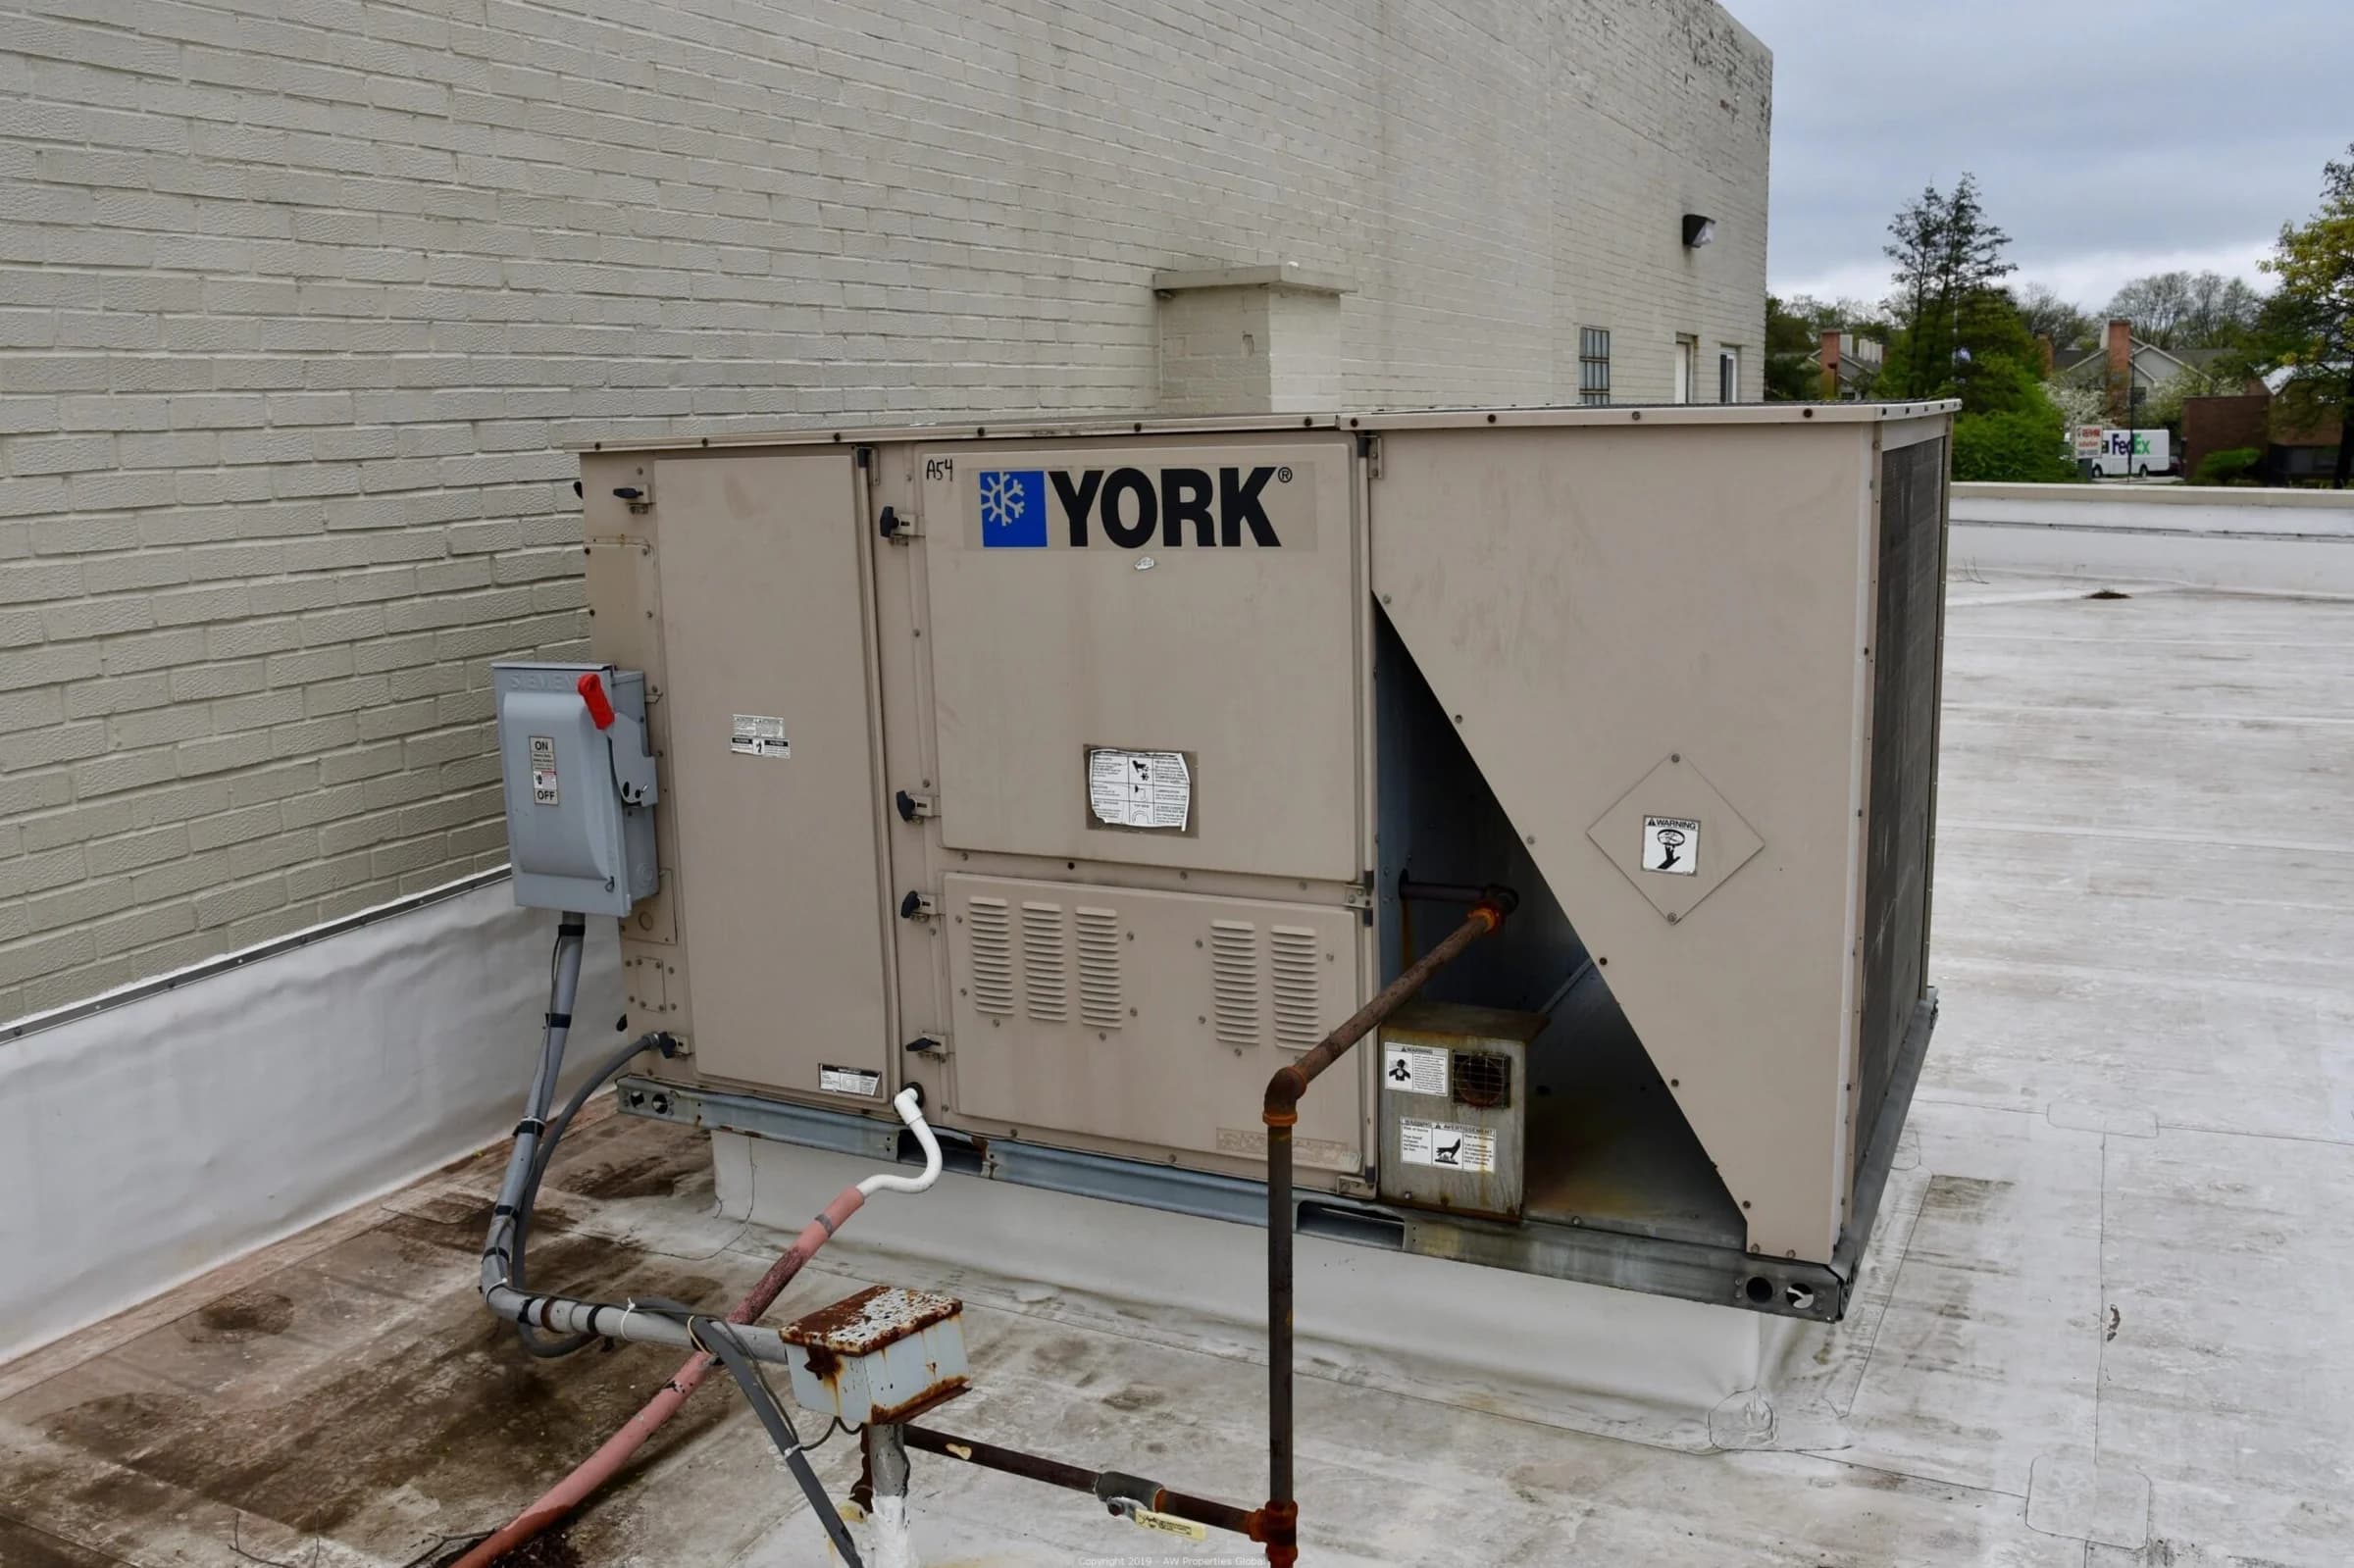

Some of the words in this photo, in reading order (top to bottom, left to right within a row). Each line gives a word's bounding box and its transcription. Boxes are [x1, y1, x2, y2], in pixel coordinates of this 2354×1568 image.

[2112, 432, 2151, 455] FedEx
[926, 458, 953, 481] A54
[1048, 466, 1282, 549] YORK
[510, 673, 578, 691] SIEMEN
[535, 740, 549, 751] ON
[537, 789, 555, 801] OFF
[1656, 818, 1696, 830] WARNING
